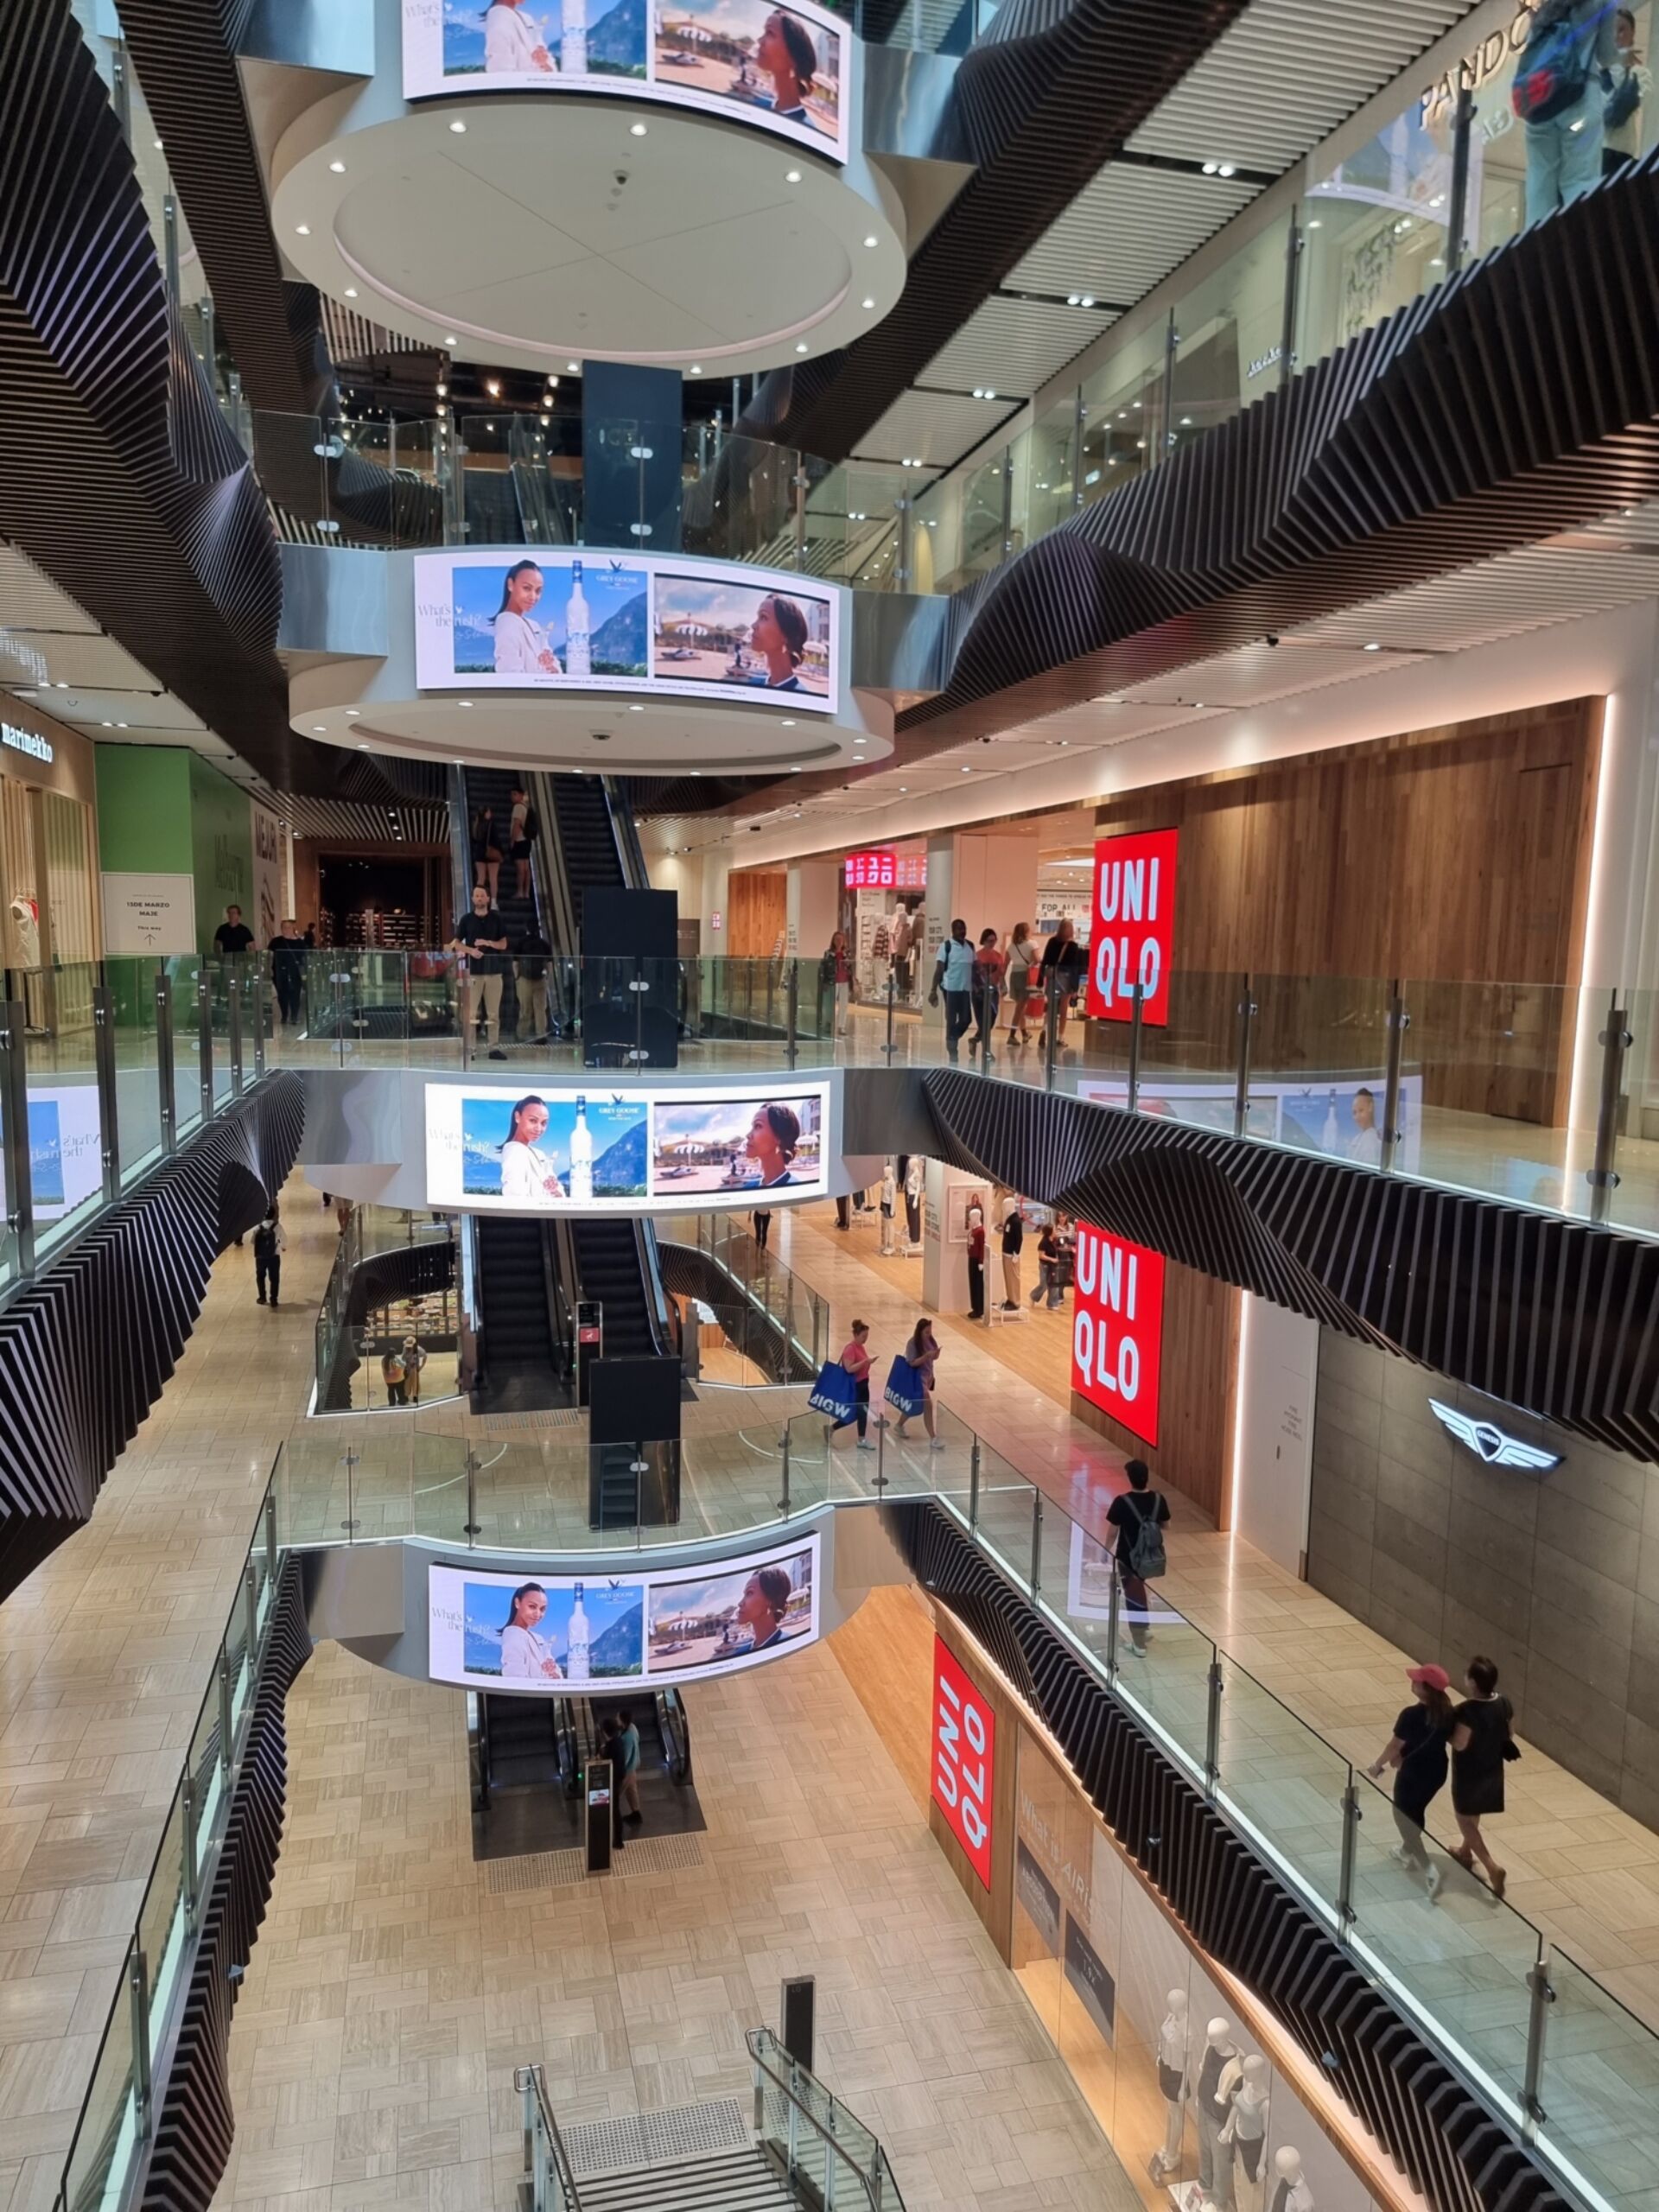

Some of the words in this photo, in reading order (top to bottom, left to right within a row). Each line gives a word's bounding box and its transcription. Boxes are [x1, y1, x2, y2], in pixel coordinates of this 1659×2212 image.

[418, 603, 451, 616] What's
[435, 616, 451, 627] the
[1, 722, 53, 763] marimekko
[1100, 857, 1160, 922] UNI
[1096, 937, 1161, 1007] QLO
[1077, 1230, 1137, 1320] UNI
[1074, 1310, 1140, 1402] QLO
[1477, 1429, 1499, 1446] GENESIS
[431, 1606, 462, 1622] What's
[448, 1621, 462, 1631] the
[938, 1675, 960, 1808] UNI
[961, 1703, 988, 1849] QLO
